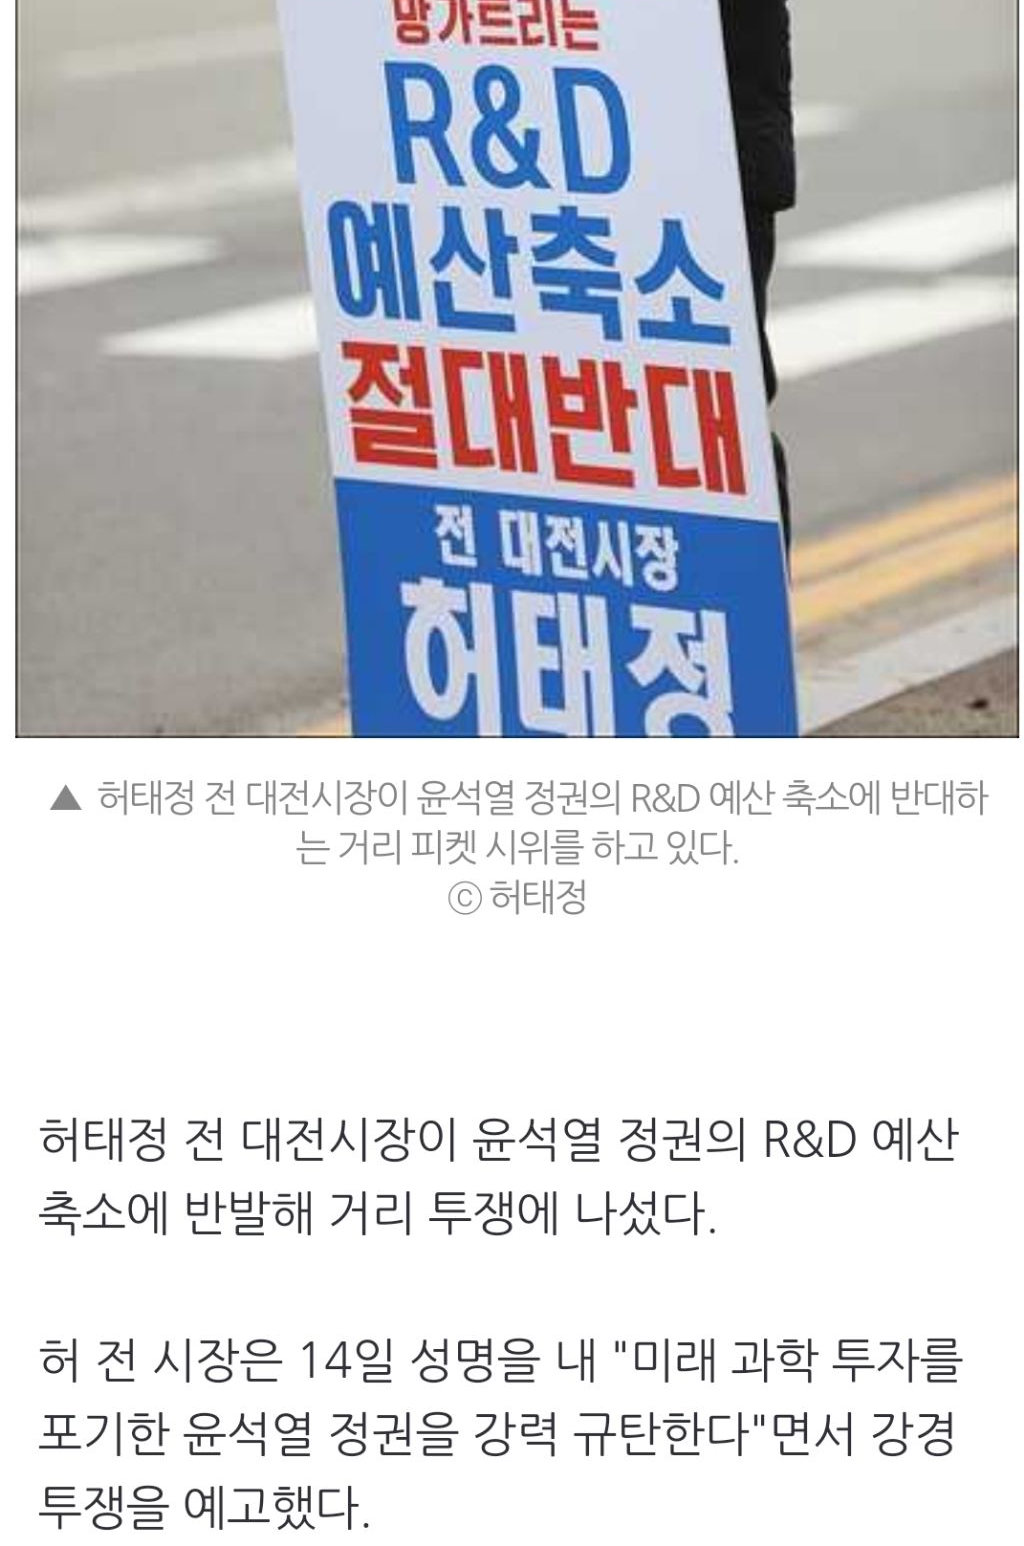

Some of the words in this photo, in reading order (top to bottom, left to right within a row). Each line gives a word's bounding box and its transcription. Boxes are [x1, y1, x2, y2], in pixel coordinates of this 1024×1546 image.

[383, 60, 632, 194] R&D
[326, 200, 732, 346] 예산축소
[341, 339, 747, 496] 절대반대
[434, 503, 478, 568] 전
[498, 508, 680, 593] 대전시장
[400, 576, 736, 737] 허태정
[97, 779, 193, 816] 허태정
[205, 779, 235, 816] 전
[247, 779, 407, 816] 대전시장이
[416, 779, 514, 817] 윤석열
[525, 779, 620, 816] 정권의
[632, 782, 701, 813] R&D
[709, 779, 776, 816] 예산
[782, 779, 880, 817] 축소에
[891, 779, 990, 816] 반대하
[296, 830, 331, 866] 는
[339, 829, 401, 866] 거리
[411, 829, 477, 866] 피켓
[486, 829, 585, 866] 시위를
[591, 829, 659, 866] 하고
[666, 829, 739, 866] 있다.
[489, 878, 585, 916] 허태정
[39, 1116, 166, 1163] 허태정
[185, 1116, 224, 1162] 전
[242, 1116, 455, 1163] 대전시장이
[472, 1116, 601, 1163] 윤석열
[619, 1116, 745, 1163] 정권의
[765, 1119, 857, 1159] R&D
[872, 1116, 960, 1163] 예산
[38, 1190, 167, 1237] 축소에
[186, 1190, 312, 1237] 반발해
[330, 1190, 411, 1237] 거리
[428, 1190, 558, 1237] 투쟁에
[577, 1190, 716, 1237] 나섰다.
[39, 1337, 77, 1384] 허
[97, 1337, 136, 1383] 전
[153, 1337, 283, 1384] 시장은
[301, 1337, 393, 1384] 14일
[411, 1337, 541, 1384] 성명을
[557, 1337, 595, 1384] 내
[614, 1337, 715, 1384] "미래
[731, 1337, 820, 1384] 과학
[831, 1337, 964, 1384] 투자를
[38, 1411, 171, 1457] 포기한
[182, 1411, 311, 1458] 윤석열
[330, 1411, 460, 1458] 정권을
[474, 1411, 556, 1458] 강력
[573, 1411, 852, 1457] 규탄한다"면서
[872, 1411, 953, 1458] 강경
[38, 1484, 170, 1531] 투쟁을
[184, 1485, 370, 1531] 예고했다.
